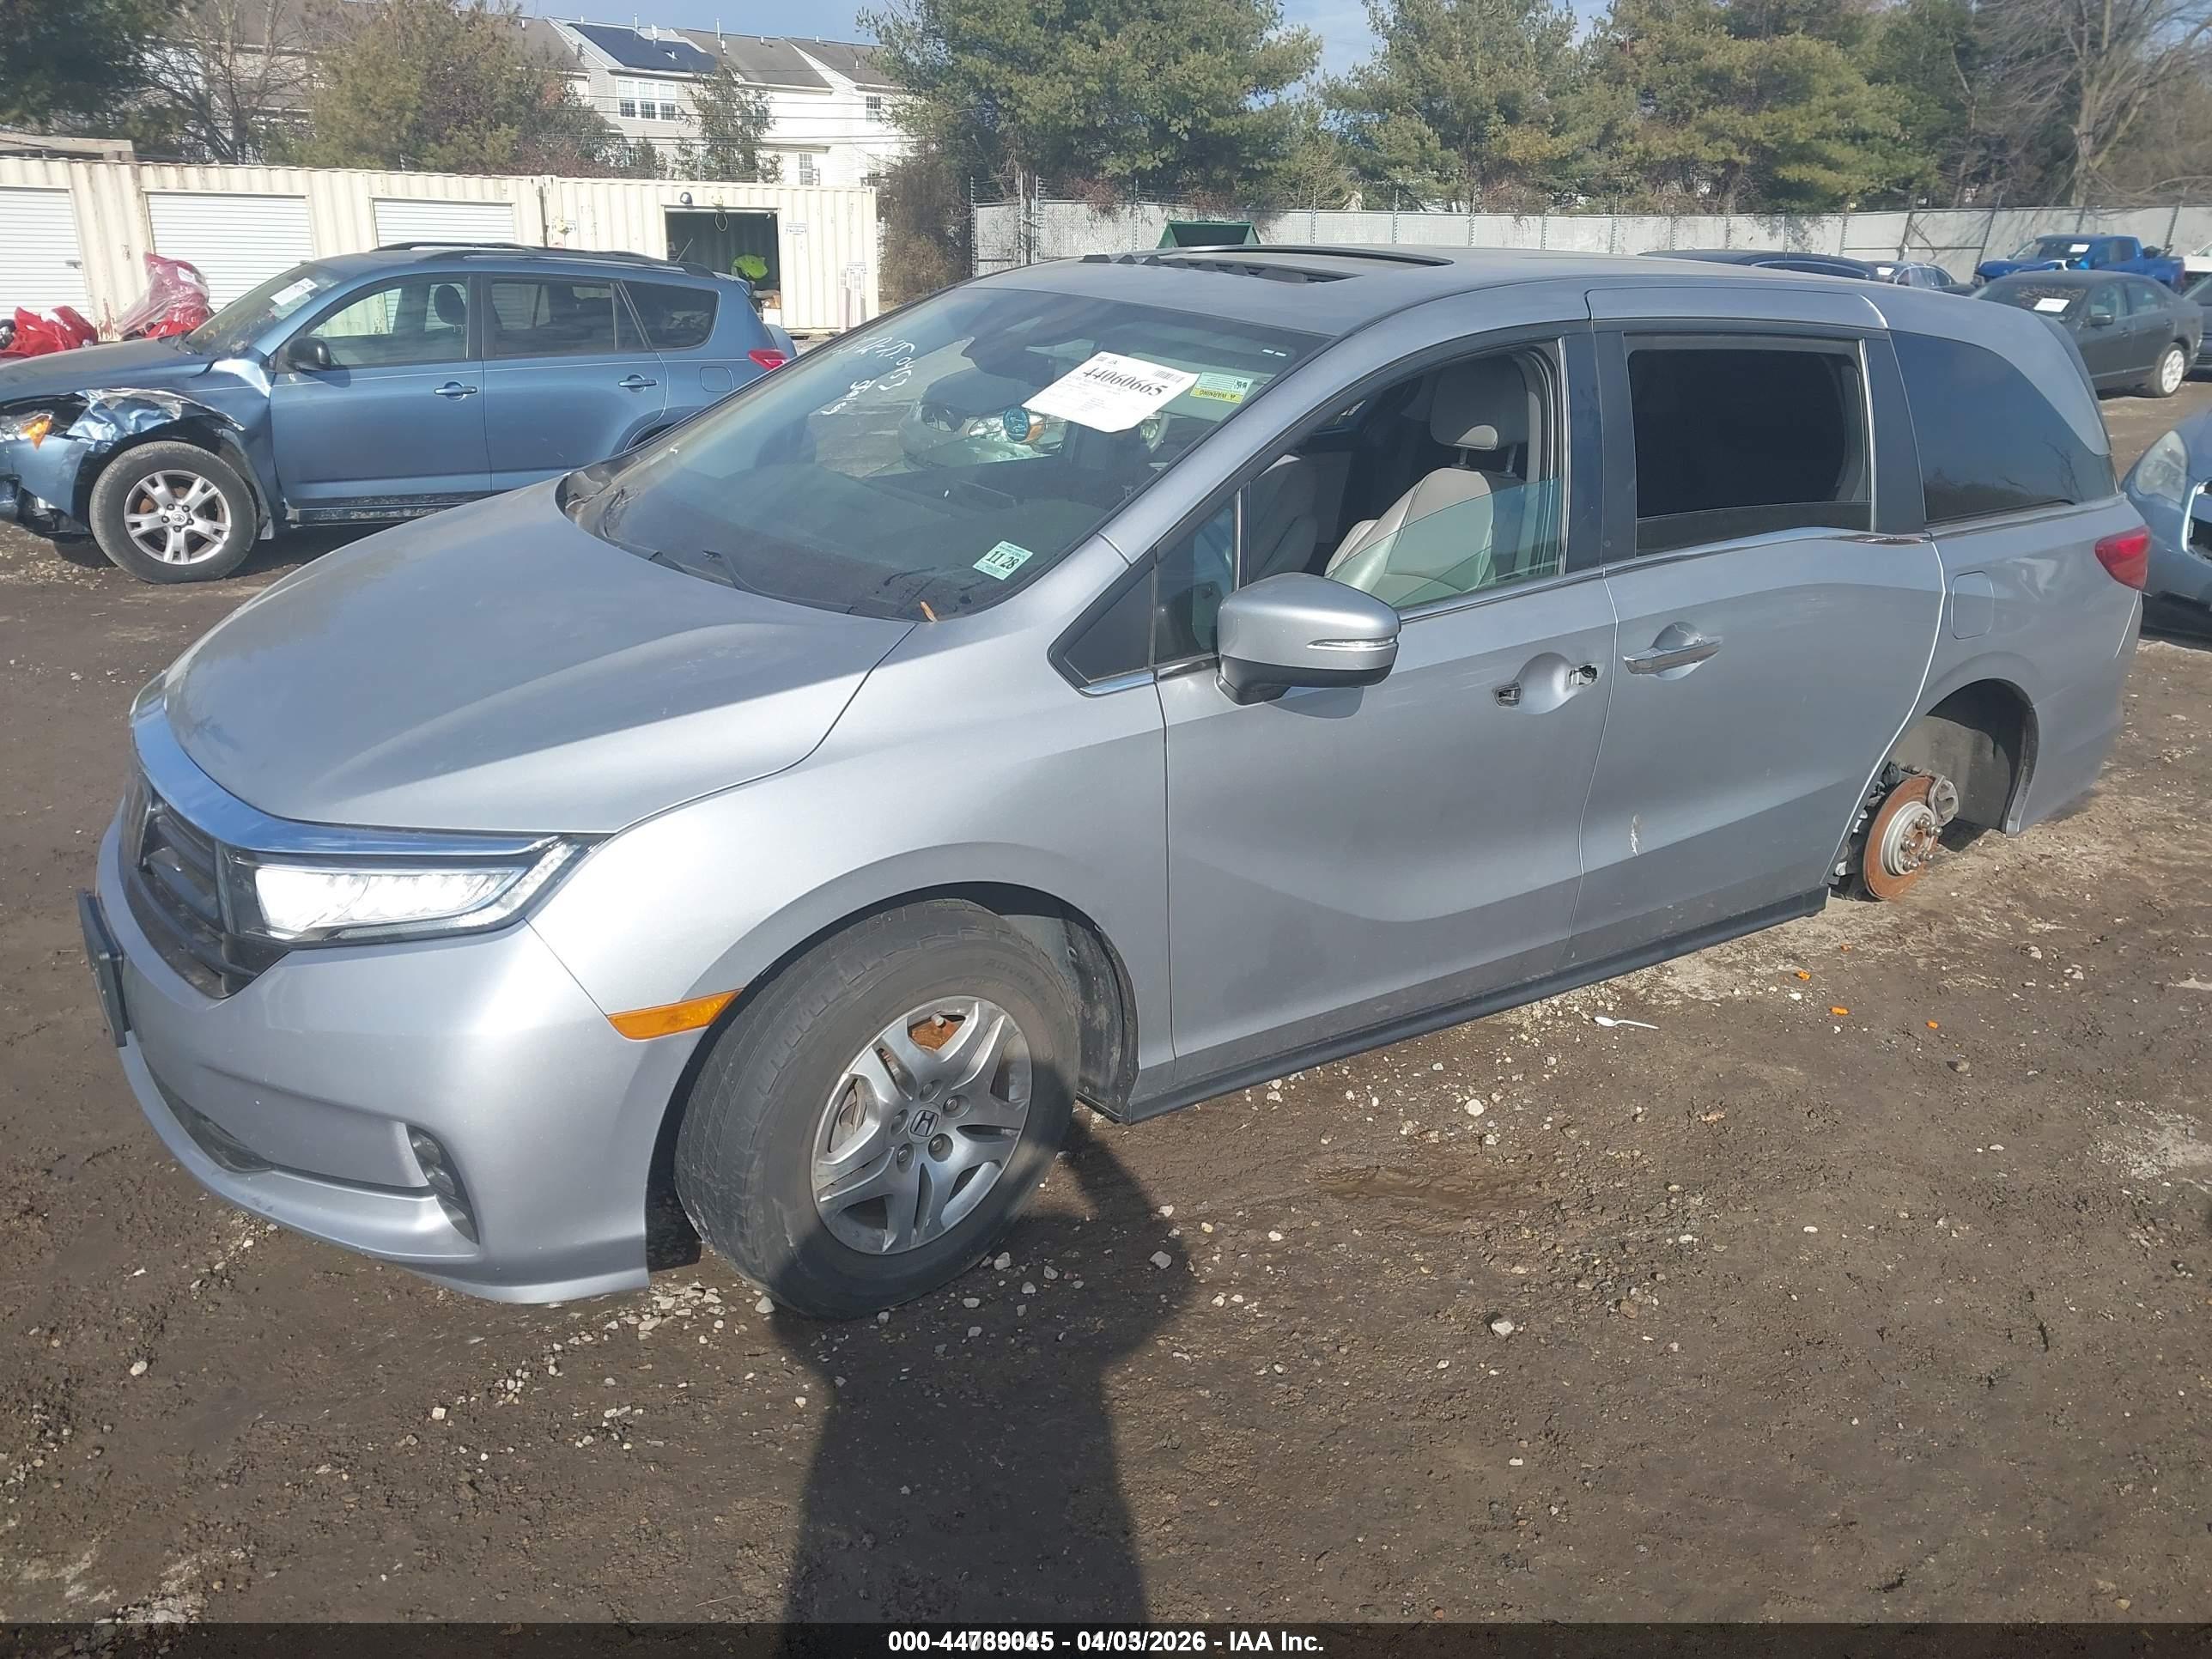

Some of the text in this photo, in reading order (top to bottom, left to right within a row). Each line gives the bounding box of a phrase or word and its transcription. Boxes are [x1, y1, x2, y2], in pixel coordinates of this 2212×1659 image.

[1083, 367, 1169, 397] 44060665
[985, 550, 1005, 564] 11
[1000, 556, 1019, 569] 28
